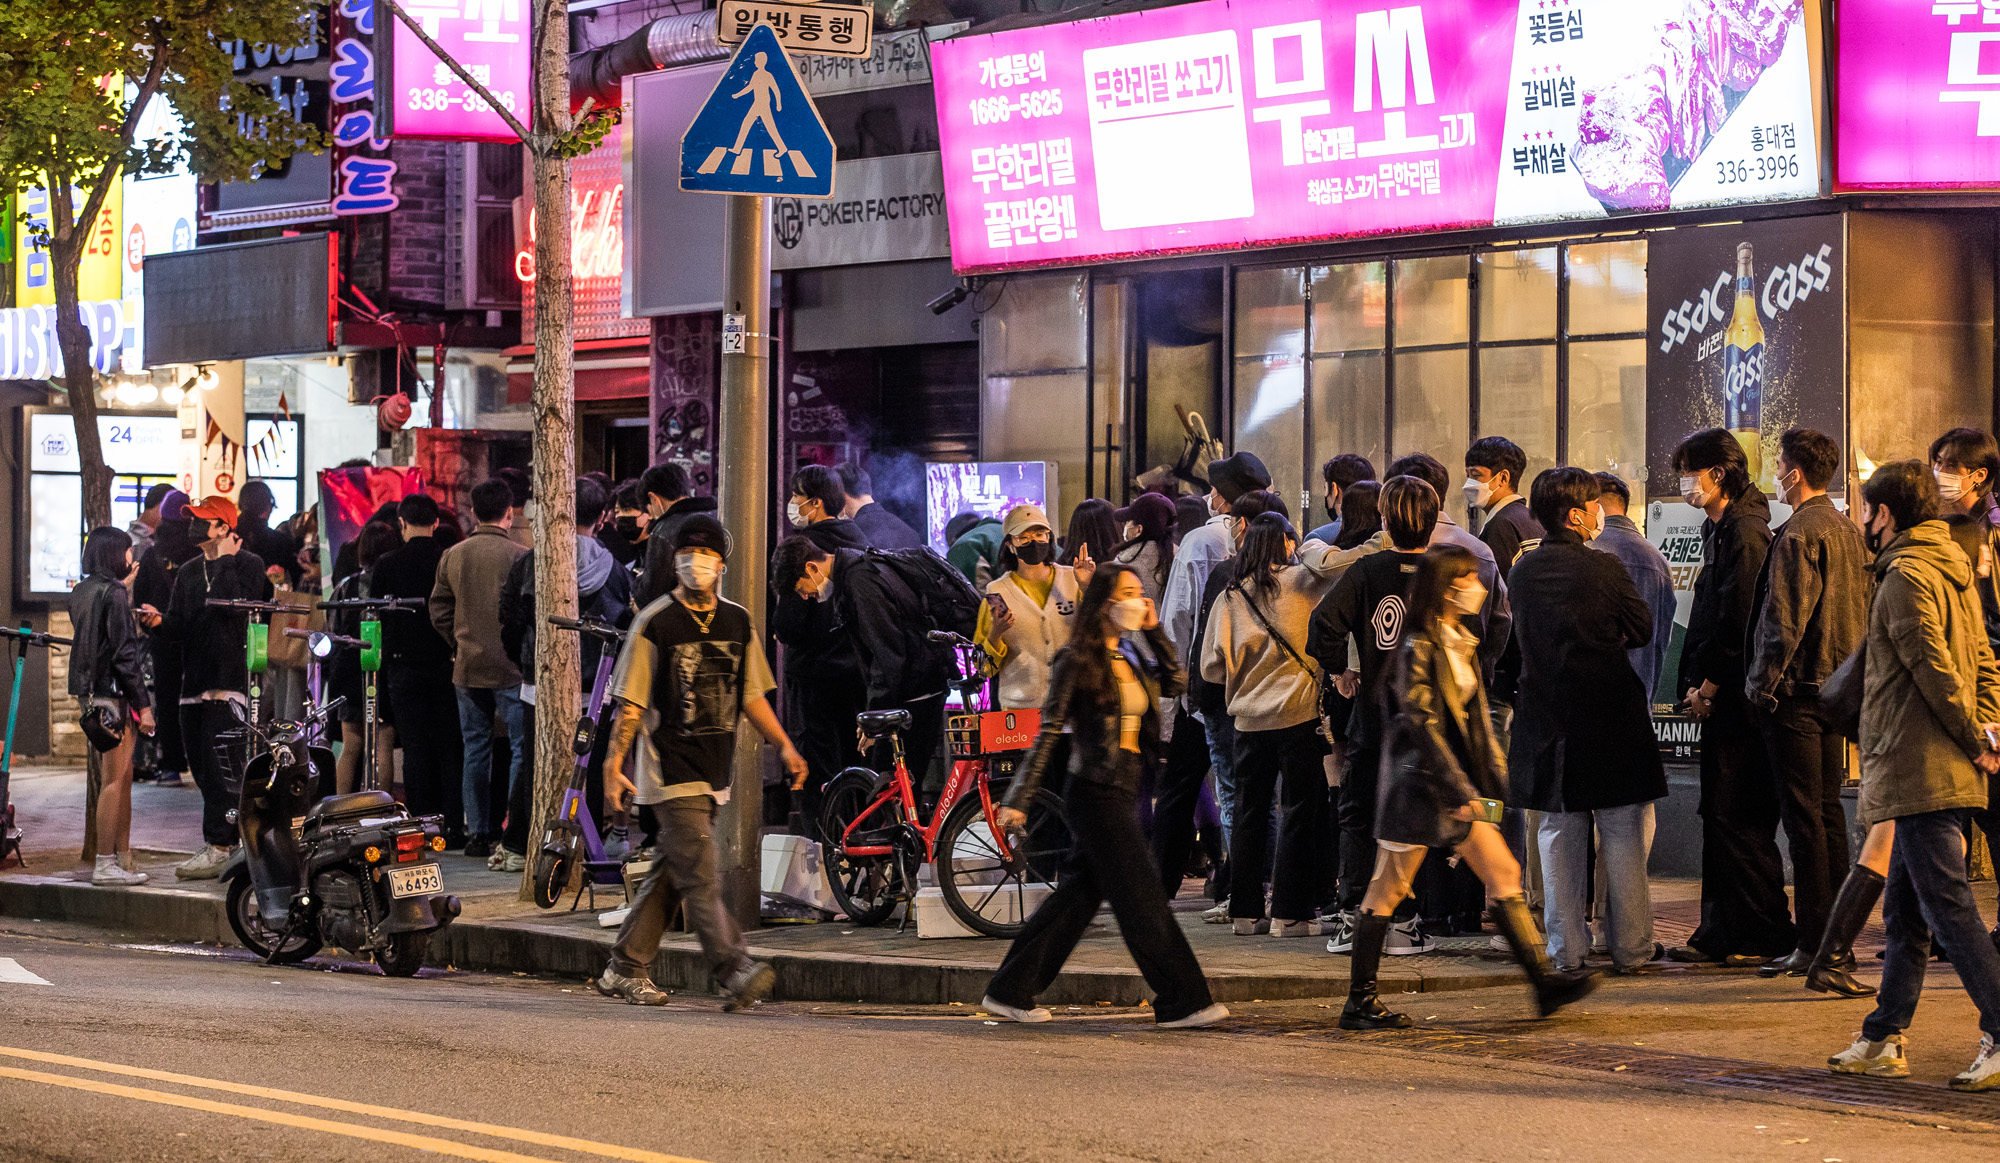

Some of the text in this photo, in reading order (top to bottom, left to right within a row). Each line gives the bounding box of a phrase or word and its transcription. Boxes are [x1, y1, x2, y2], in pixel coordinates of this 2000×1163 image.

[735, 9, 854, 44] 일방통행
[1529, 9, 1583, 45] 꽃등심
[801, 55, 854, 83] 이자카야
[979, 50, 1047, 89] 가맹문의
[1094, 54, 1233, 109] 무한리필 쏘고기
[969, 88, 1063, 125] 1666-5625
[1522, 76, 1576, 111] 갈비살
[1439, 112, 1476, 149] 고기
[1751, 122, 1796, 151] 홍대점
[971, 137, 1076, 194] 무한리필
[1513, 143, 1566, 176] 부채살
[1716, 154, 1799, 184] 336-3996
[1307, 159, 1441, 206] 최상급 소고기 무한리필
[807, 202, 863, 227] POKER
[867, 192, 945, 222] FACTORY
[984, 194, 1078, 248] 끝판왕!!
[724, 333, 741, 350] 1-2
[110, 426, 132, 443] 24
[995, 733, 1028, 744] elecle
[940, 778, 958, 819] elecle
[406, 876, 438, 892] 6493
